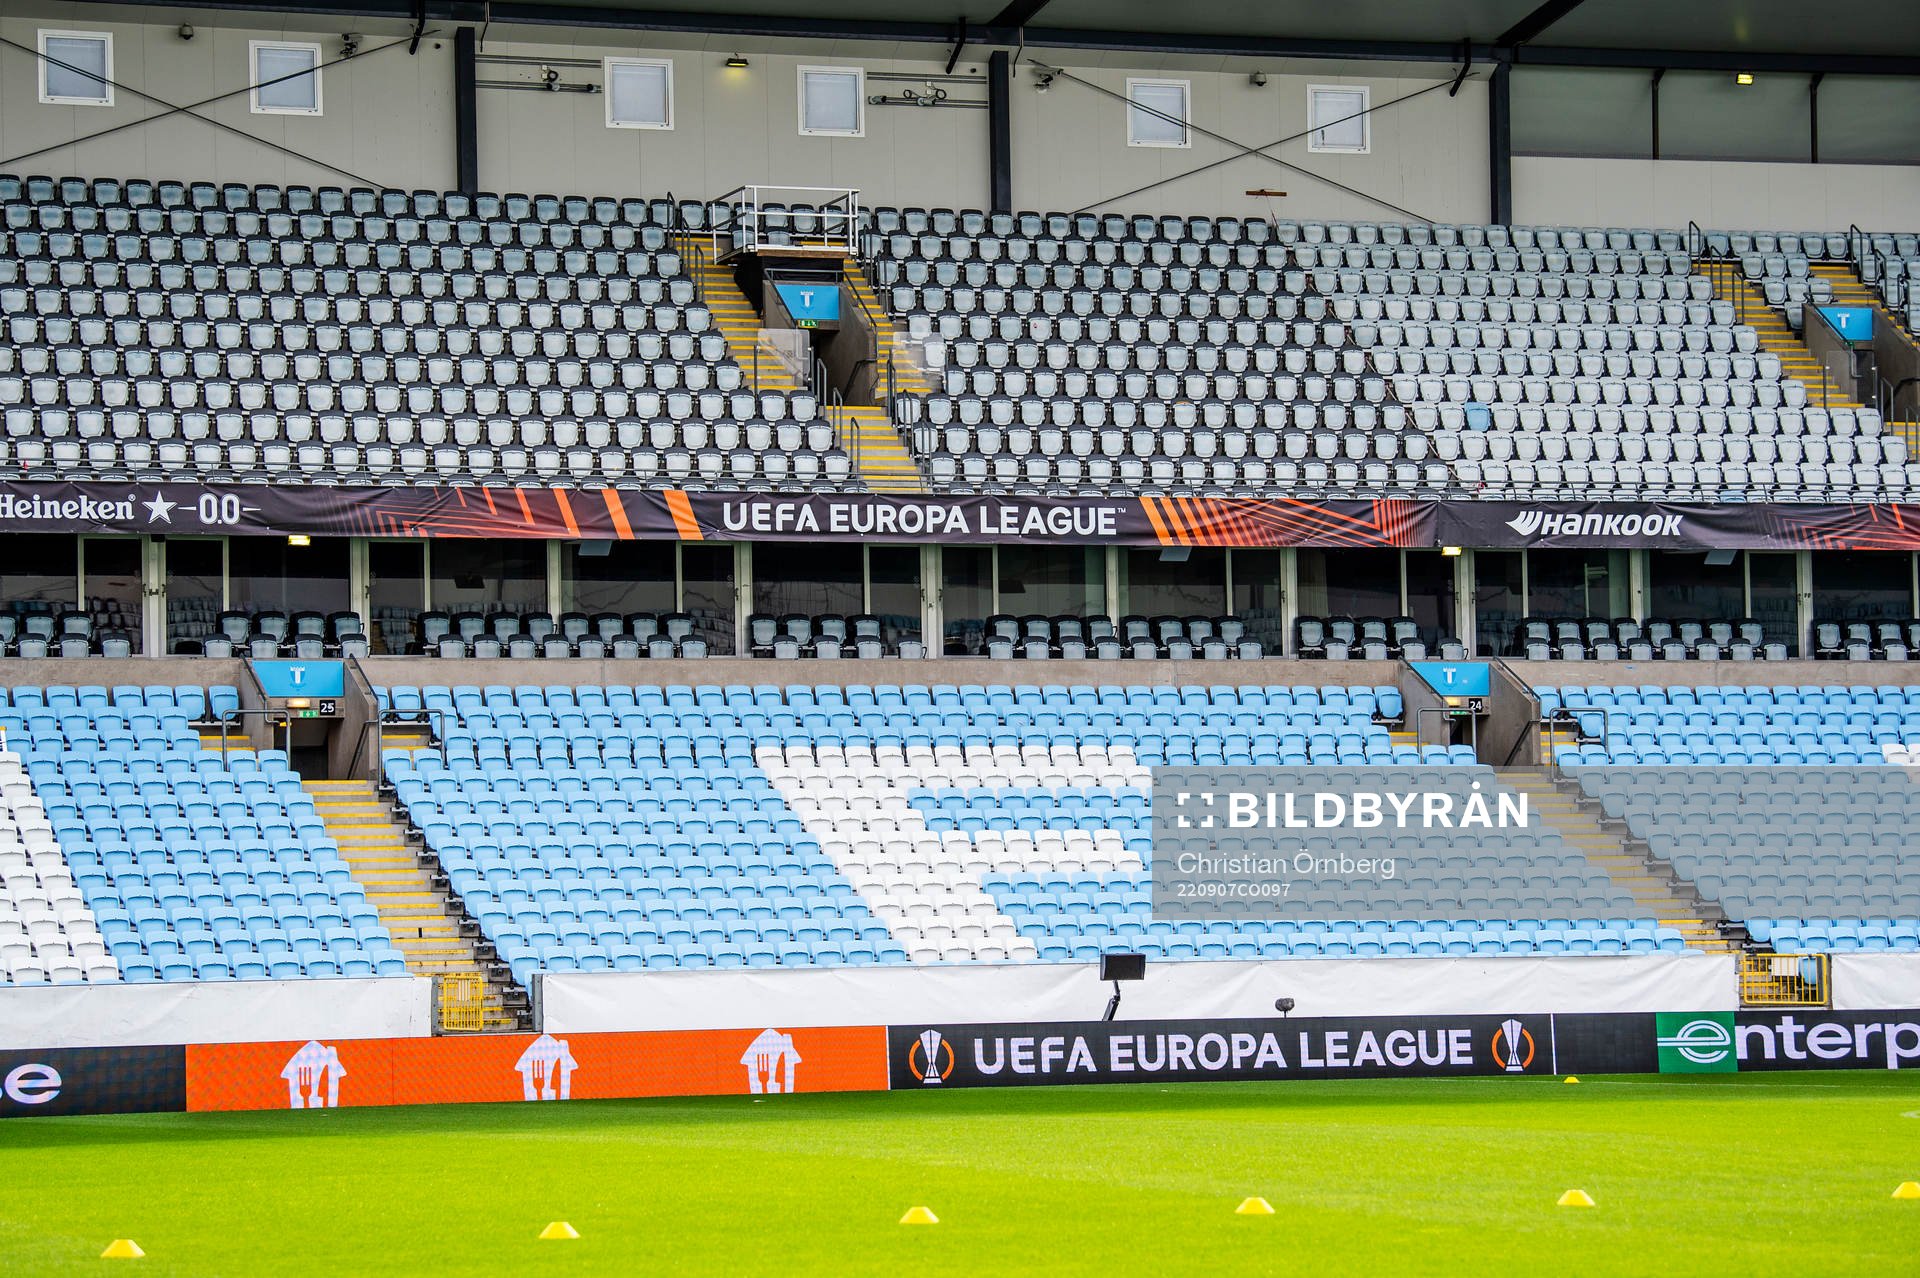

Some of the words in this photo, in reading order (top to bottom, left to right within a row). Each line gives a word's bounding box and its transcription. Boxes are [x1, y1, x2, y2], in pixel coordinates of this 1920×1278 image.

[722, 502, 821, 532] UEFA
[829, 503, 971, 535] EUROPA
[320, 702, 335, 713] 25
[1469, 700, 1482, 711] 24
[973, 1036, 1098, 1075] UEFA
[1109, 1032, 1288, 1072] EUROPA
[1299, 1029, 1474, 1068] LEAGUE
